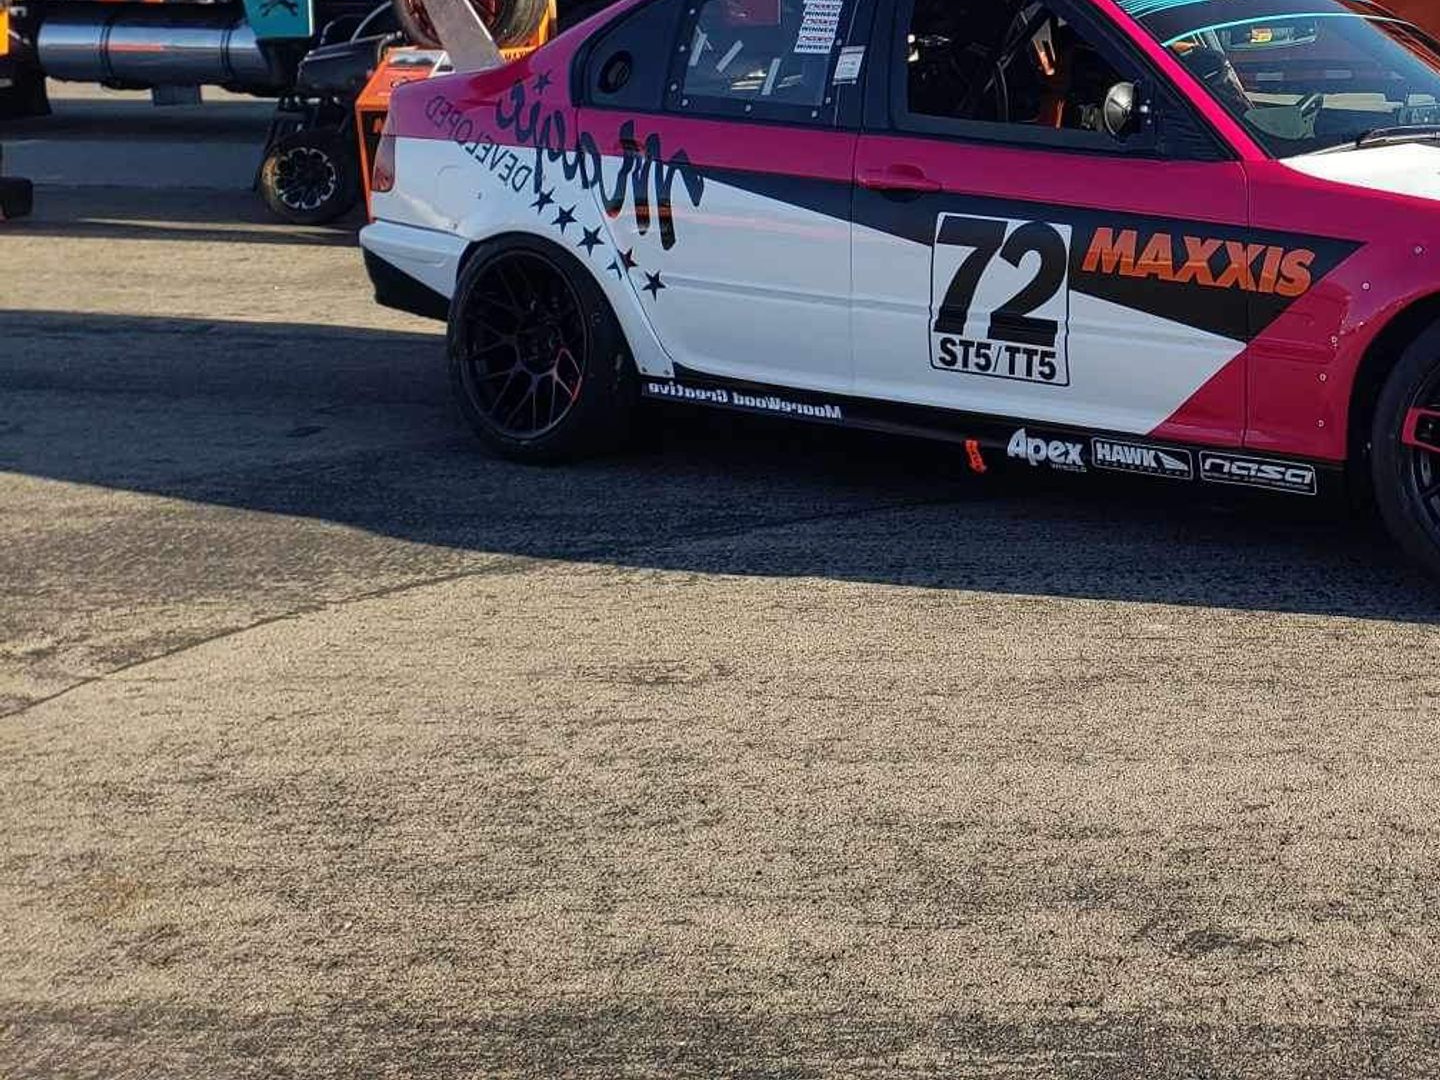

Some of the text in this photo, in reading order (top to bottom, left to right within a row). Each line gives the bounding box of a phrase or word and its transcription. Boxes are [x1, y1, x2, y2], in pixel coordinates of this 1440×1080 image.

[934, 217, 1068, 347] 72
[1081, 226, 1317, 297] MAXXIS
[938, 339, 1057, 382] ST5/TT5
[1007, 428, 1085, 466] Apex
[1096, 442, 1158, 469] HAWK
